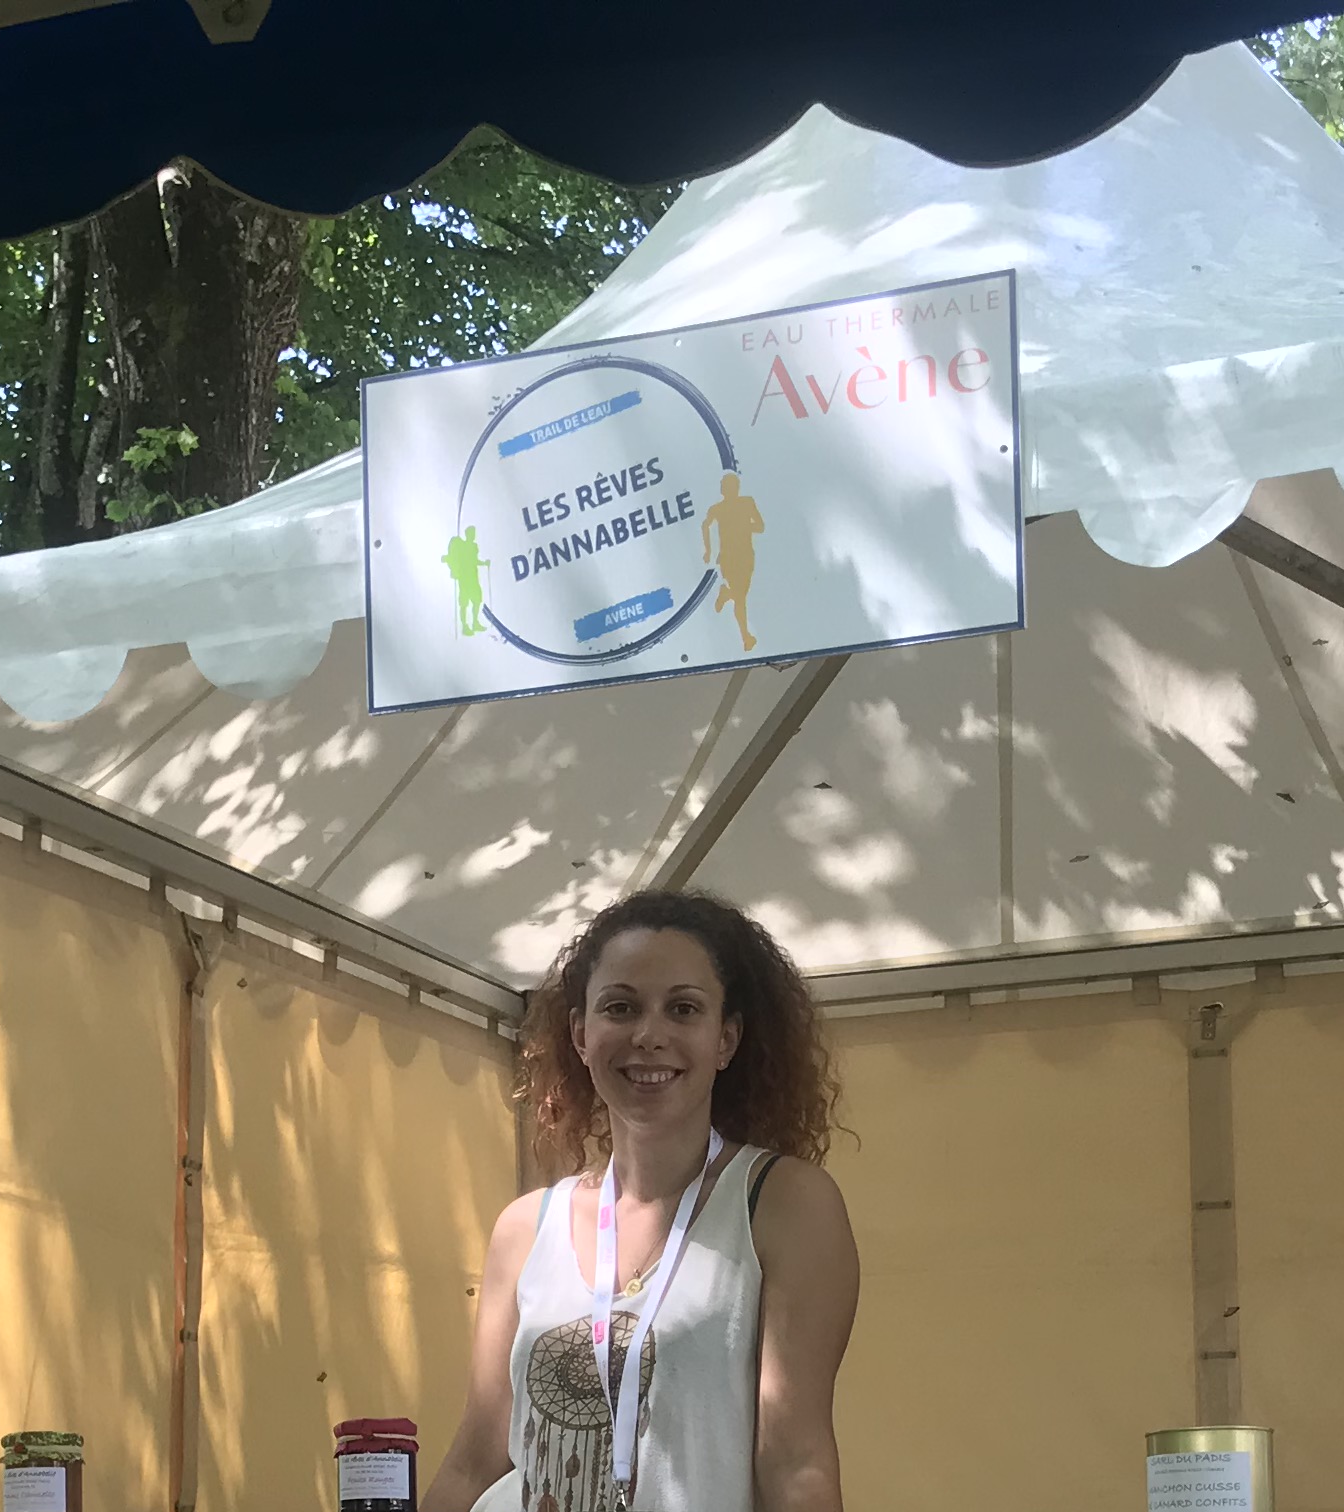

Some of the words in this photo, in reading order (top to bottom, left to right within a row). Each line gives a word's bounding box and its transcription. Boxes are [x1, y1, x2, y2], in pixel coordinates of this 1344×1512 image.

[742, 323, 803, 352] EAU
[825, 290, 1000, 338] THERMALE
[750, 346, 991, 427] Avène
[529, 422, 563, 443] TRAIL
[563, 414, 580, 431] DE
[521, 492, 571, 532] LES
[575, 456, 665, 512] RÊVES
[511, 490, 695, 582] D'ANNABELLE
[1196, 1482, 1241, 1492] CUISSE
[1196, 1498, 1248, 1507] CONFITS
